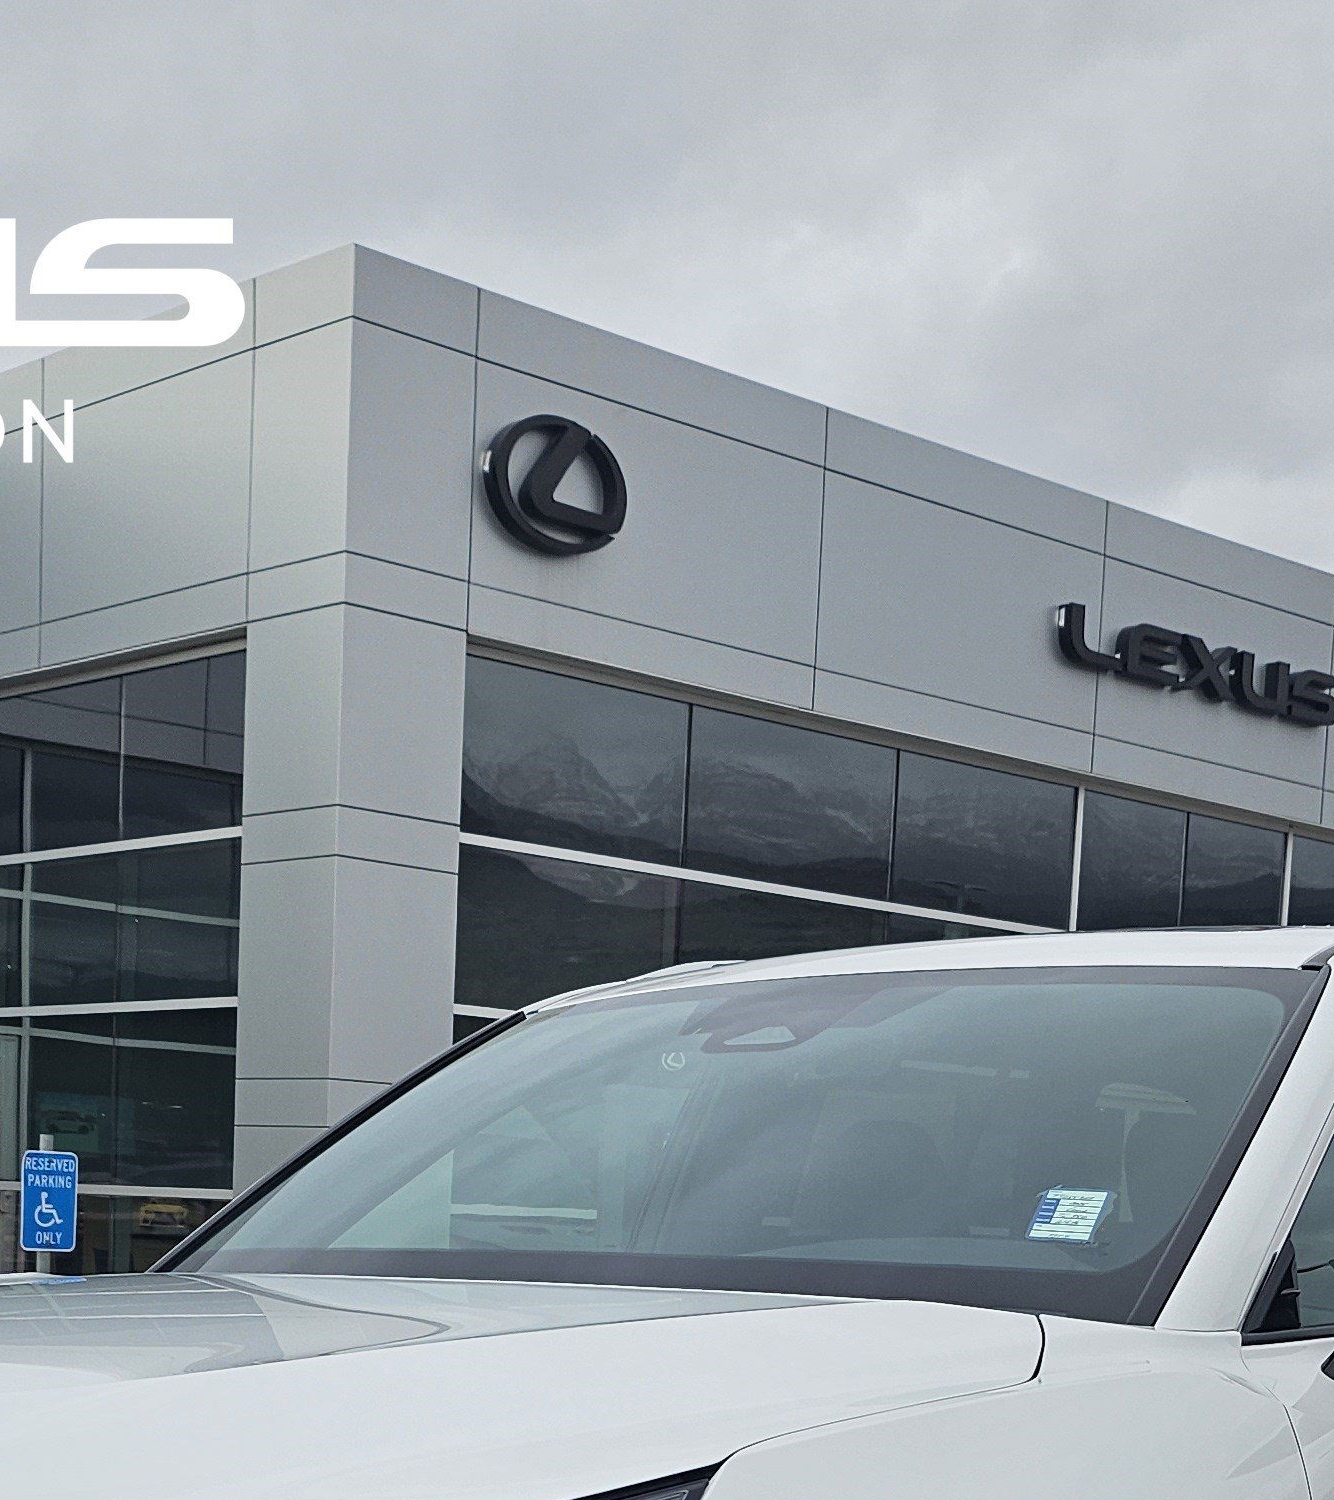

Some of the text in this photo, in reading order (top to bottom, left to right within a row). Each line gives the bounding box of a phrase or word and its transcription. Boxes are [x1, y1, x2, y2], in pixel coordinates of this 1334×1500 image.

[26, 1157, 75, 1172] RESERVED
[28, 1174, 72, 1188] PARKING
[36, 1232, 62, 1244] ONLY
